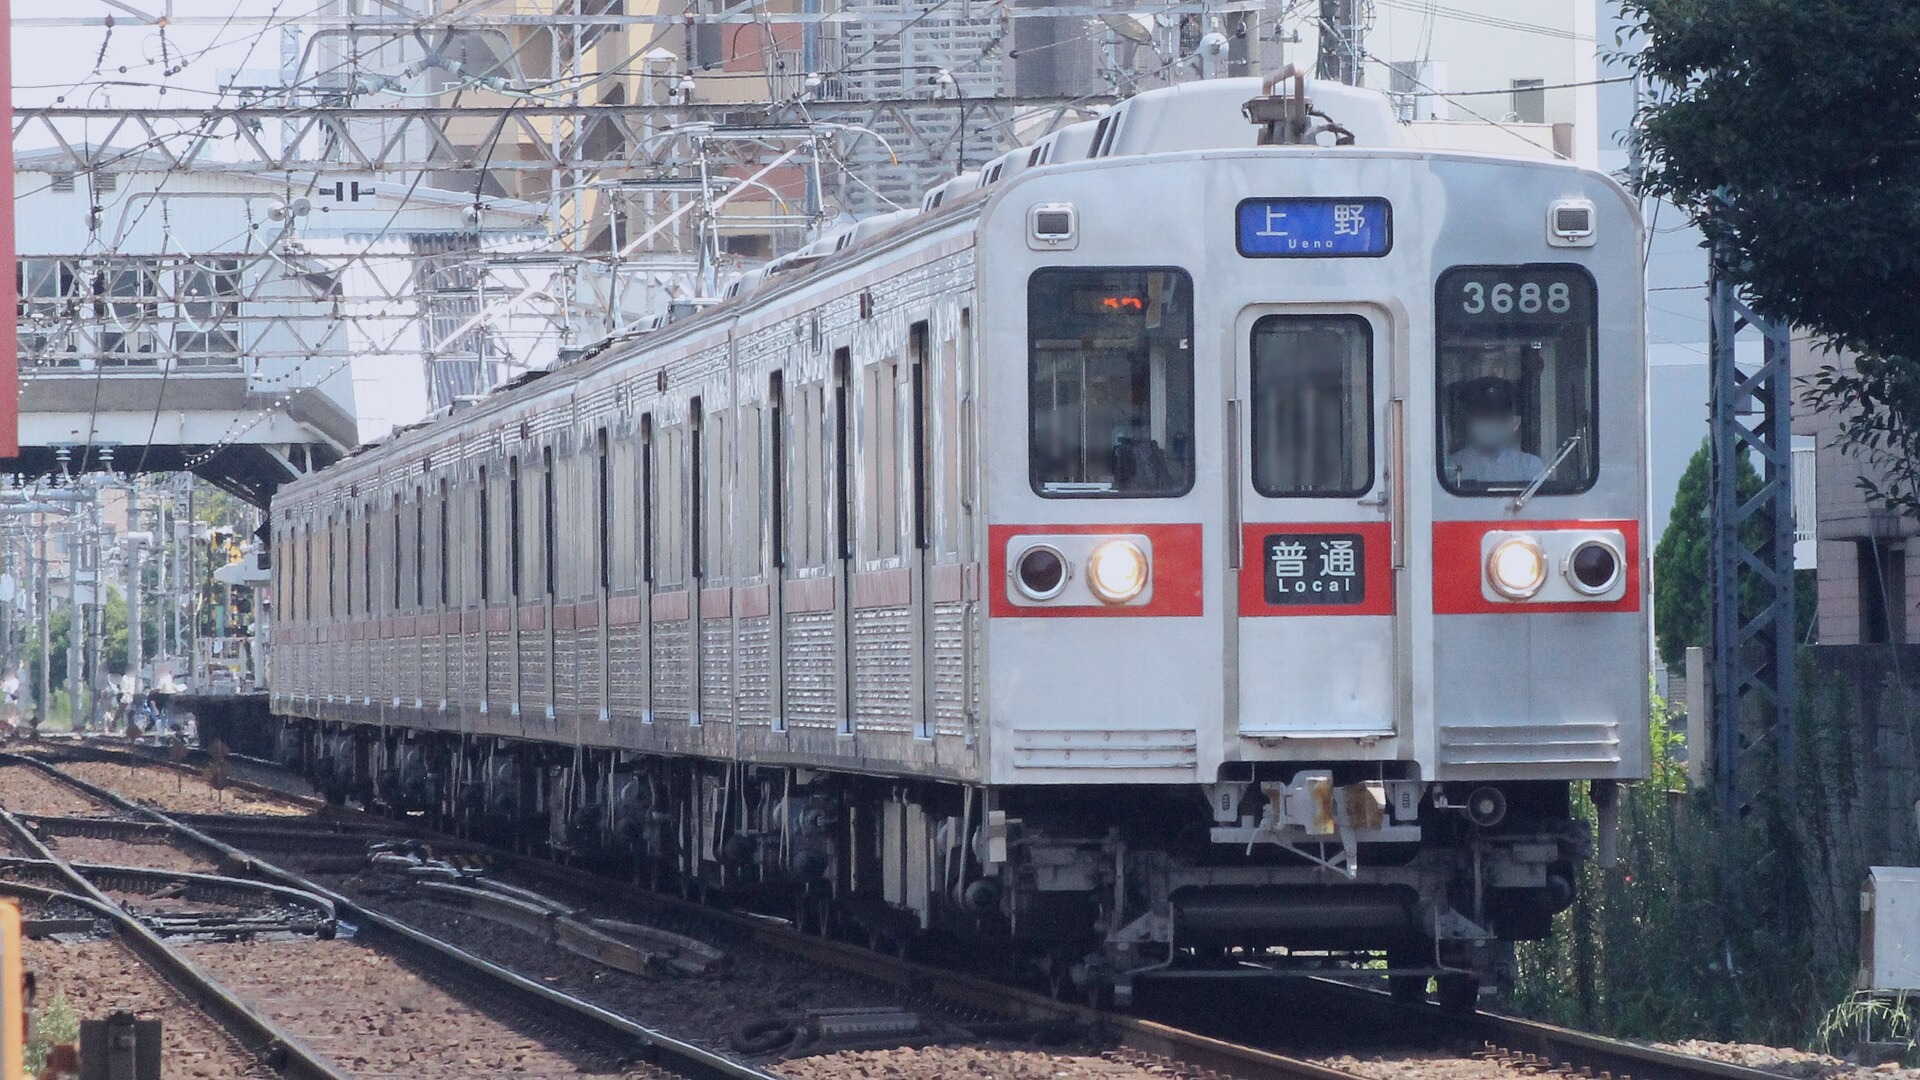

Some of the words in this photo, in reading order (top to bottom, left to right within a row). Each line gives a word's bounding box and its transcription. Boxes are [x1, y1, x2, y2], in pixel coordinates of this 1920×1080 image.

[1256, 205, 1365, 236] 上野
[1288, 239, 1334, 249] Ueno
[1463, 282, 1571, 314] 3688
[1271, 540, 1356, 577] 普通
[1278, 578, 1350, 593] Local
